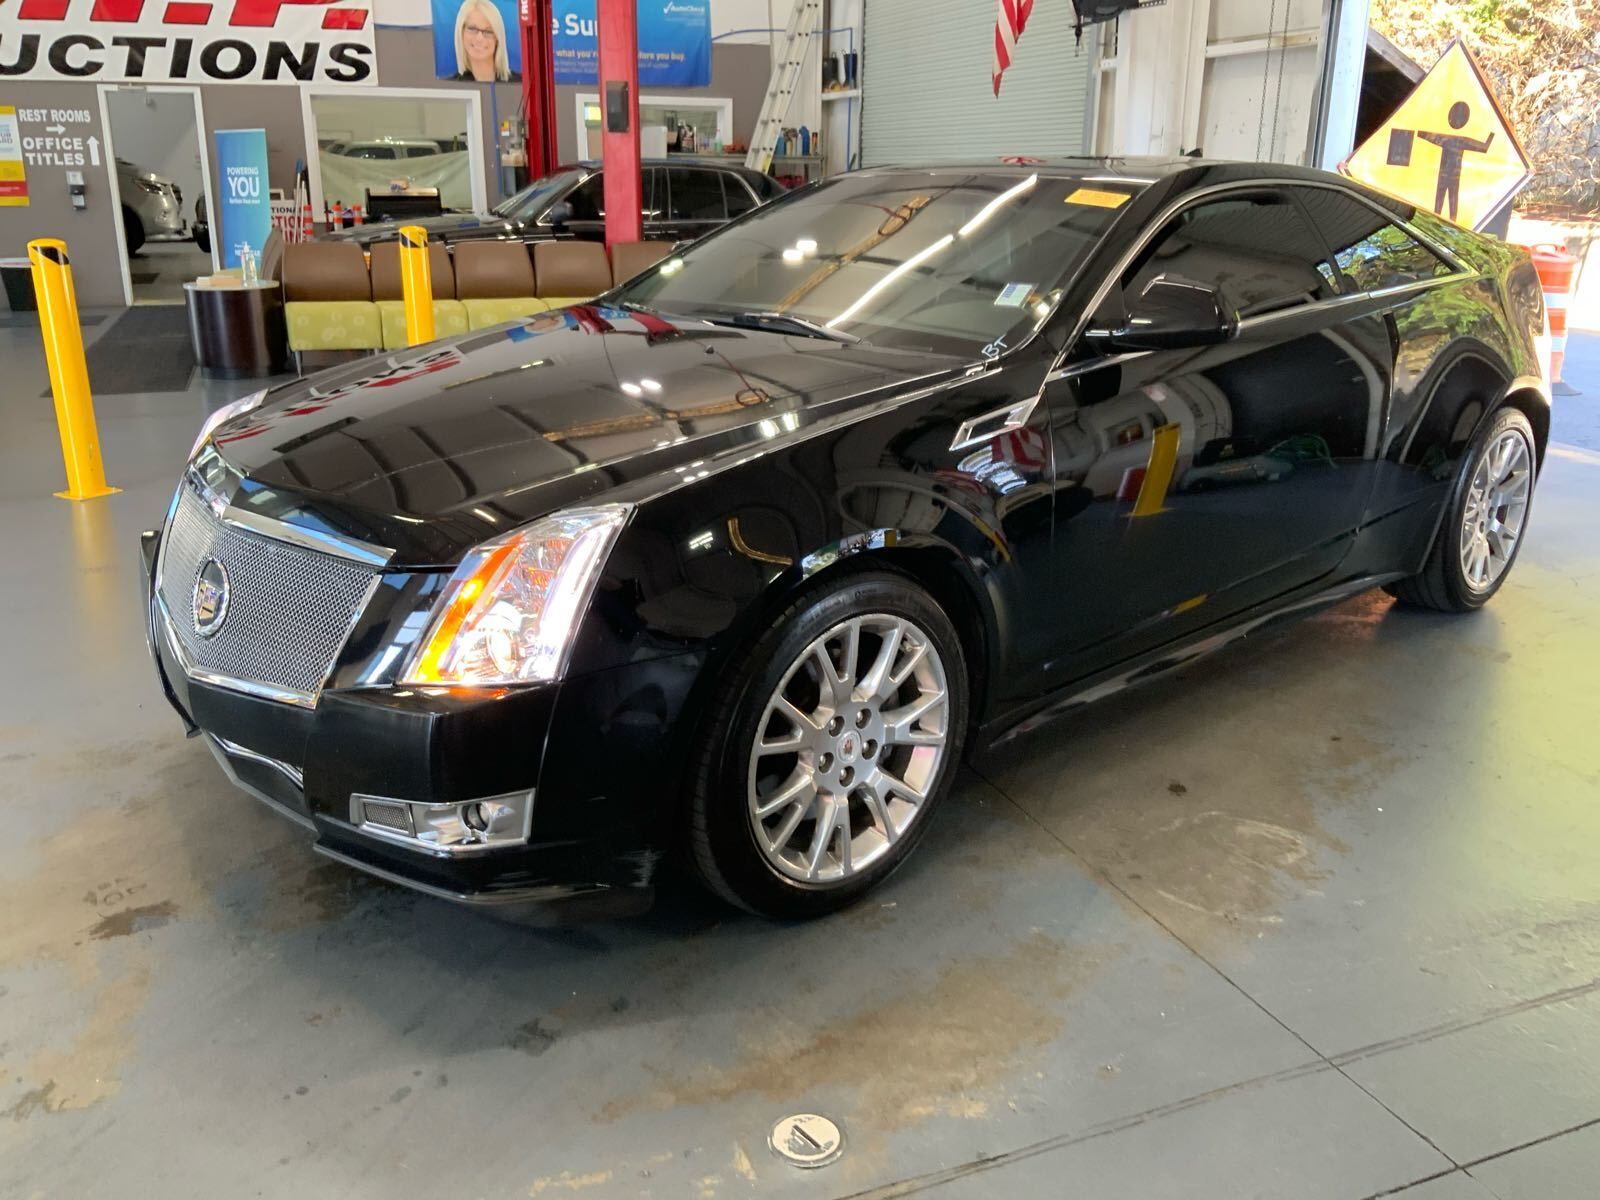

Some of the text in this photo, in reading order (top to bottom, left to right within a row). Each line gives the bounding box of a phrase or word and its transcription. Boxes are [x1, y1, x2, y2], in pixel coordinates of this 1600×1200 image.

[565, 13, 598, 36] Su
[18, 109, 91, 123] REST ROOMS
[22, 137, 84, 150] OFFICE
[25, 153, 85, 166] TITLES
[227, 167, 259, 175] POWERING
[228, 177, 260, 197] YOU
